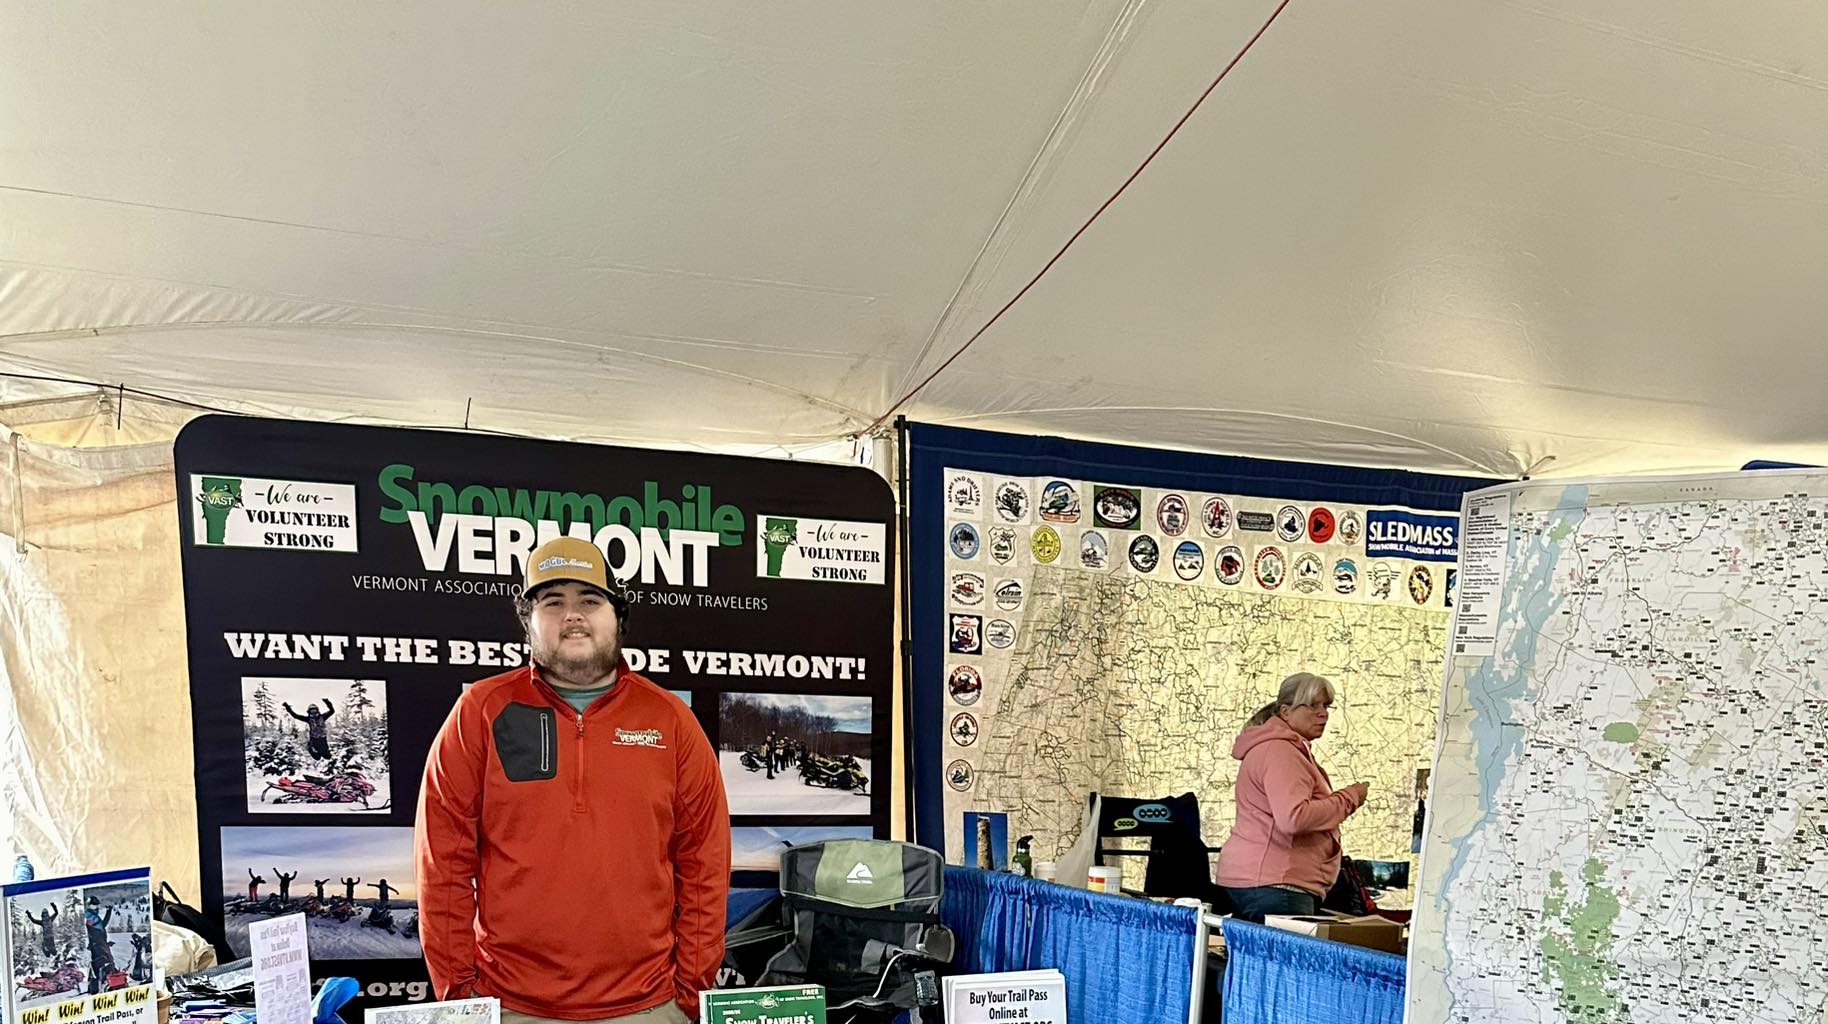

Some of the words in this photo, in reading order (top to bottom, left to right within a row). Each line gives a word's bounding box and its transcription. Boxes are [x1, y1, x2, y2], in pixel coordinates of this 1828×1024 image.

[207, 495, 234, 506] VAST
[378, 463, 745, 546] Snowmobile
[246, 509, 350, 528] VOLUNTEER
[264, 532, 334, 549] STRONG
[770, 533, 791, 543] VAST
[1369, 521, 1453, 546] SLEDMASS
[799, 546, 881, 564] VOLUNTEER
[811, 566, 868, 582] STRONG
[352, 575, 428, 592] VERMONT
[435, 580, 522, 598] ASSOCIATIO
[625, 590, 644, 605] OF
[650, 591, 691, 608] SNOW
[697, 594, 768, 611] TRAVELERS
[223, 632, 349, 661] WANT
[356, 636, 439, 664] THE
[447, 639, 532, 667] BES
[682, 651, 866, 681] VERMONT!
[951, 665, 980, 681] FLORIDA
[620, 734, 659, 744] VERMONT
[357, 981, 428, 1001] .org
[969, 992, 985, 1007] Buy
[987, 991, 1007, 1005] Your
[1008, 989, 1027, 1003] Trail
[1029, 989, 1048, 1001] Pass
[58, 1001, 84, 1020] Win!
[92, 994, 118, 1013] Win!
[125, 988, 150, 1005] Win!
[115, 1009, 134, 1024] Pass,
[136, 1008, 144, 1017] or
[989, 1007, 1017, 1020] Online
[1018, 1007, 1028, 1018] at
